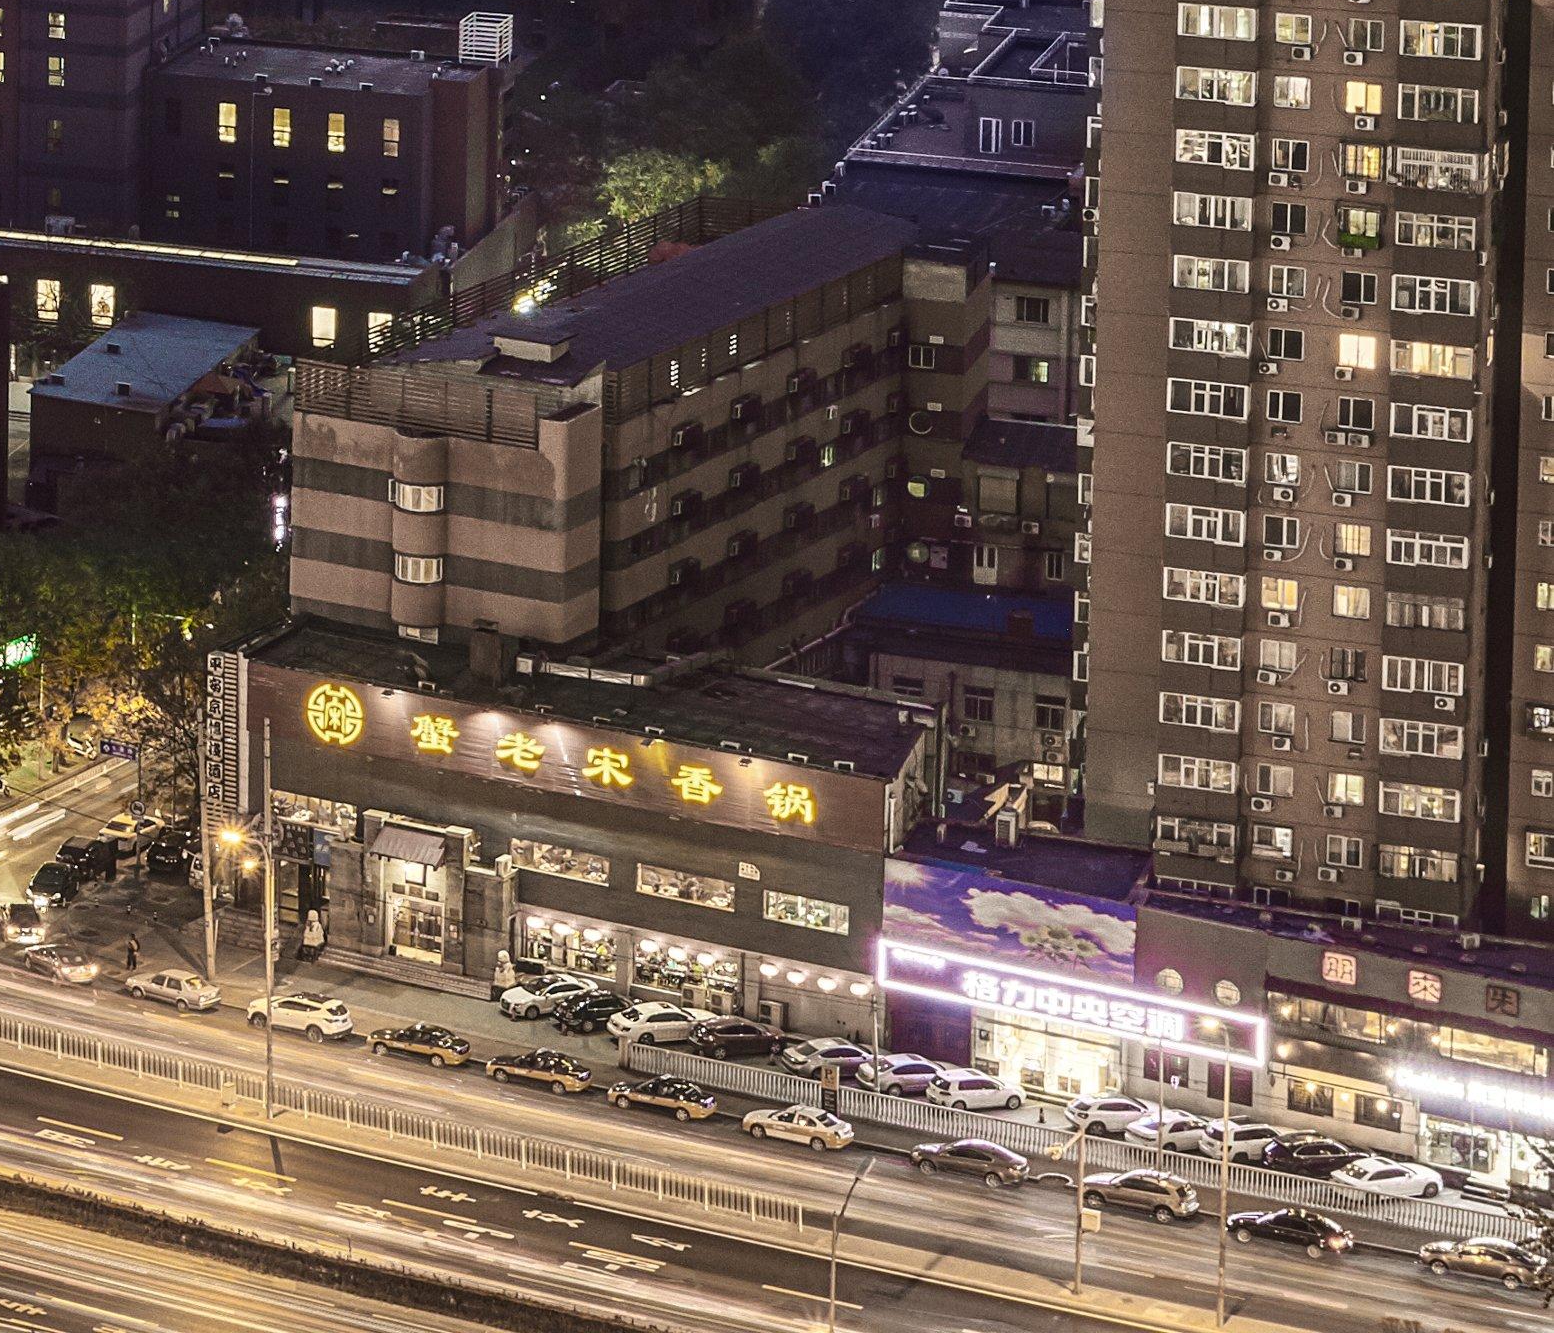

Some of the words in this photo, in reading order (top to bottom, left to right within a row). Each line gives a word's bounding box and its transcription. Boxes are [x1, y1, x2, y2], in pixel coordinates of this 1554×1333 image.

[411, 716, 816, 823] 蟹老宋香锅
[963, 971, 1186, 1042] 格力中央空调
